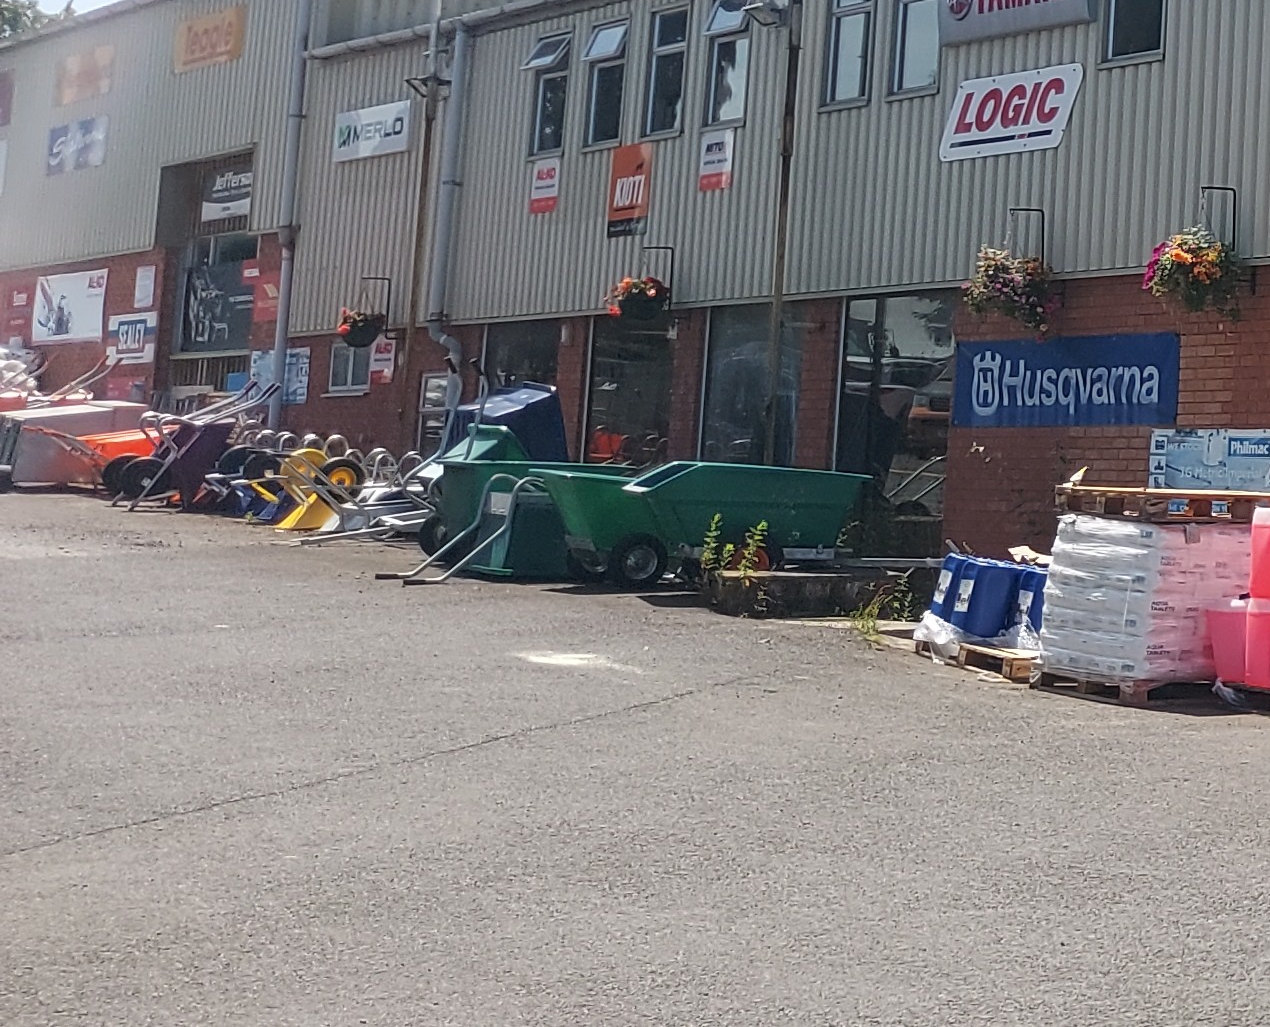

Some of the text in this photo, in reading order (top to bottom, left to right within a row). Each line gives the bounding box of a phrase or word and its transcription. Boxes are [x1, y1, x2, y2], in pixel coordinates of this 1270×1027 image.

[953, 77, 1066, 136] LOGIC
[351, 116, 404, 144] MERLO
[613, 173, 646, 208] KIOTI
[1001, 358, 1160, 415] Husqvarna
[1230, 440, 1270, 456] Philmac
